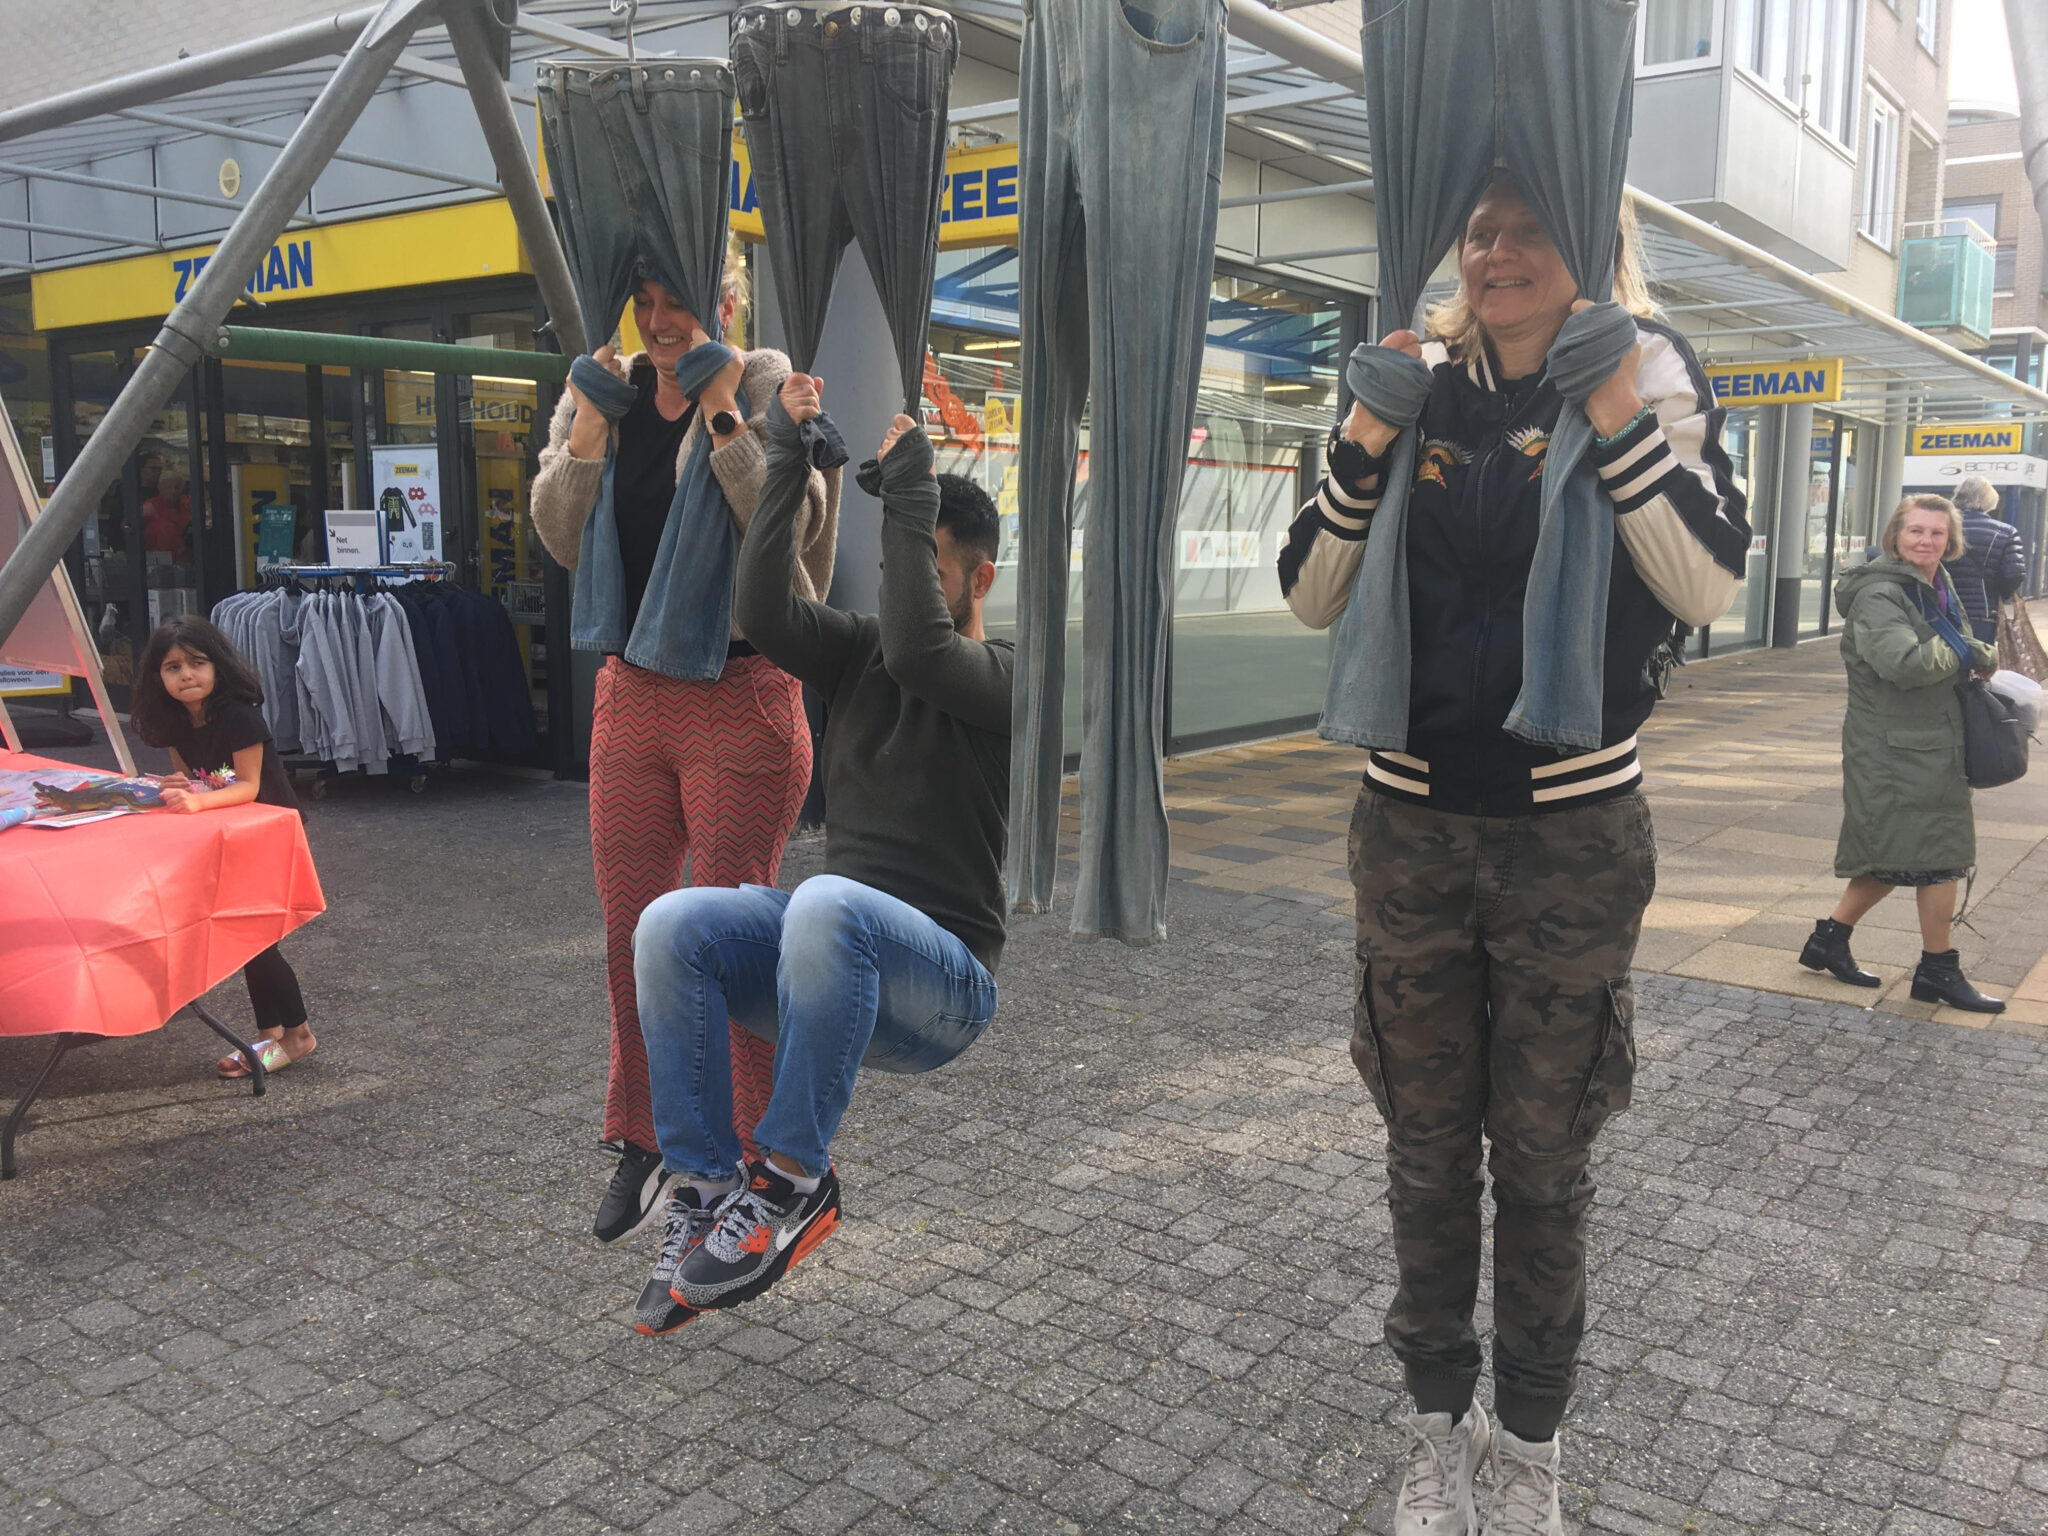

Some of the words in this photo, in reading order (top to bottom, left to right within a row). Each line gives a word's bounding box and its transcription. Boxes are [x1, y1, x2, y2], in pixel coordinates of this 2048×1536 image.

[173, 240, 313, 304] ZAN
[1709, 370, 1825, 398] EEMAN
[1920, 432, 2012, 449] ZEEMAN
[395, 466, 417, 474] ZEEMAN
[336, 536, 348, 544] Net
[336, 546, 361, 554] binnen.
